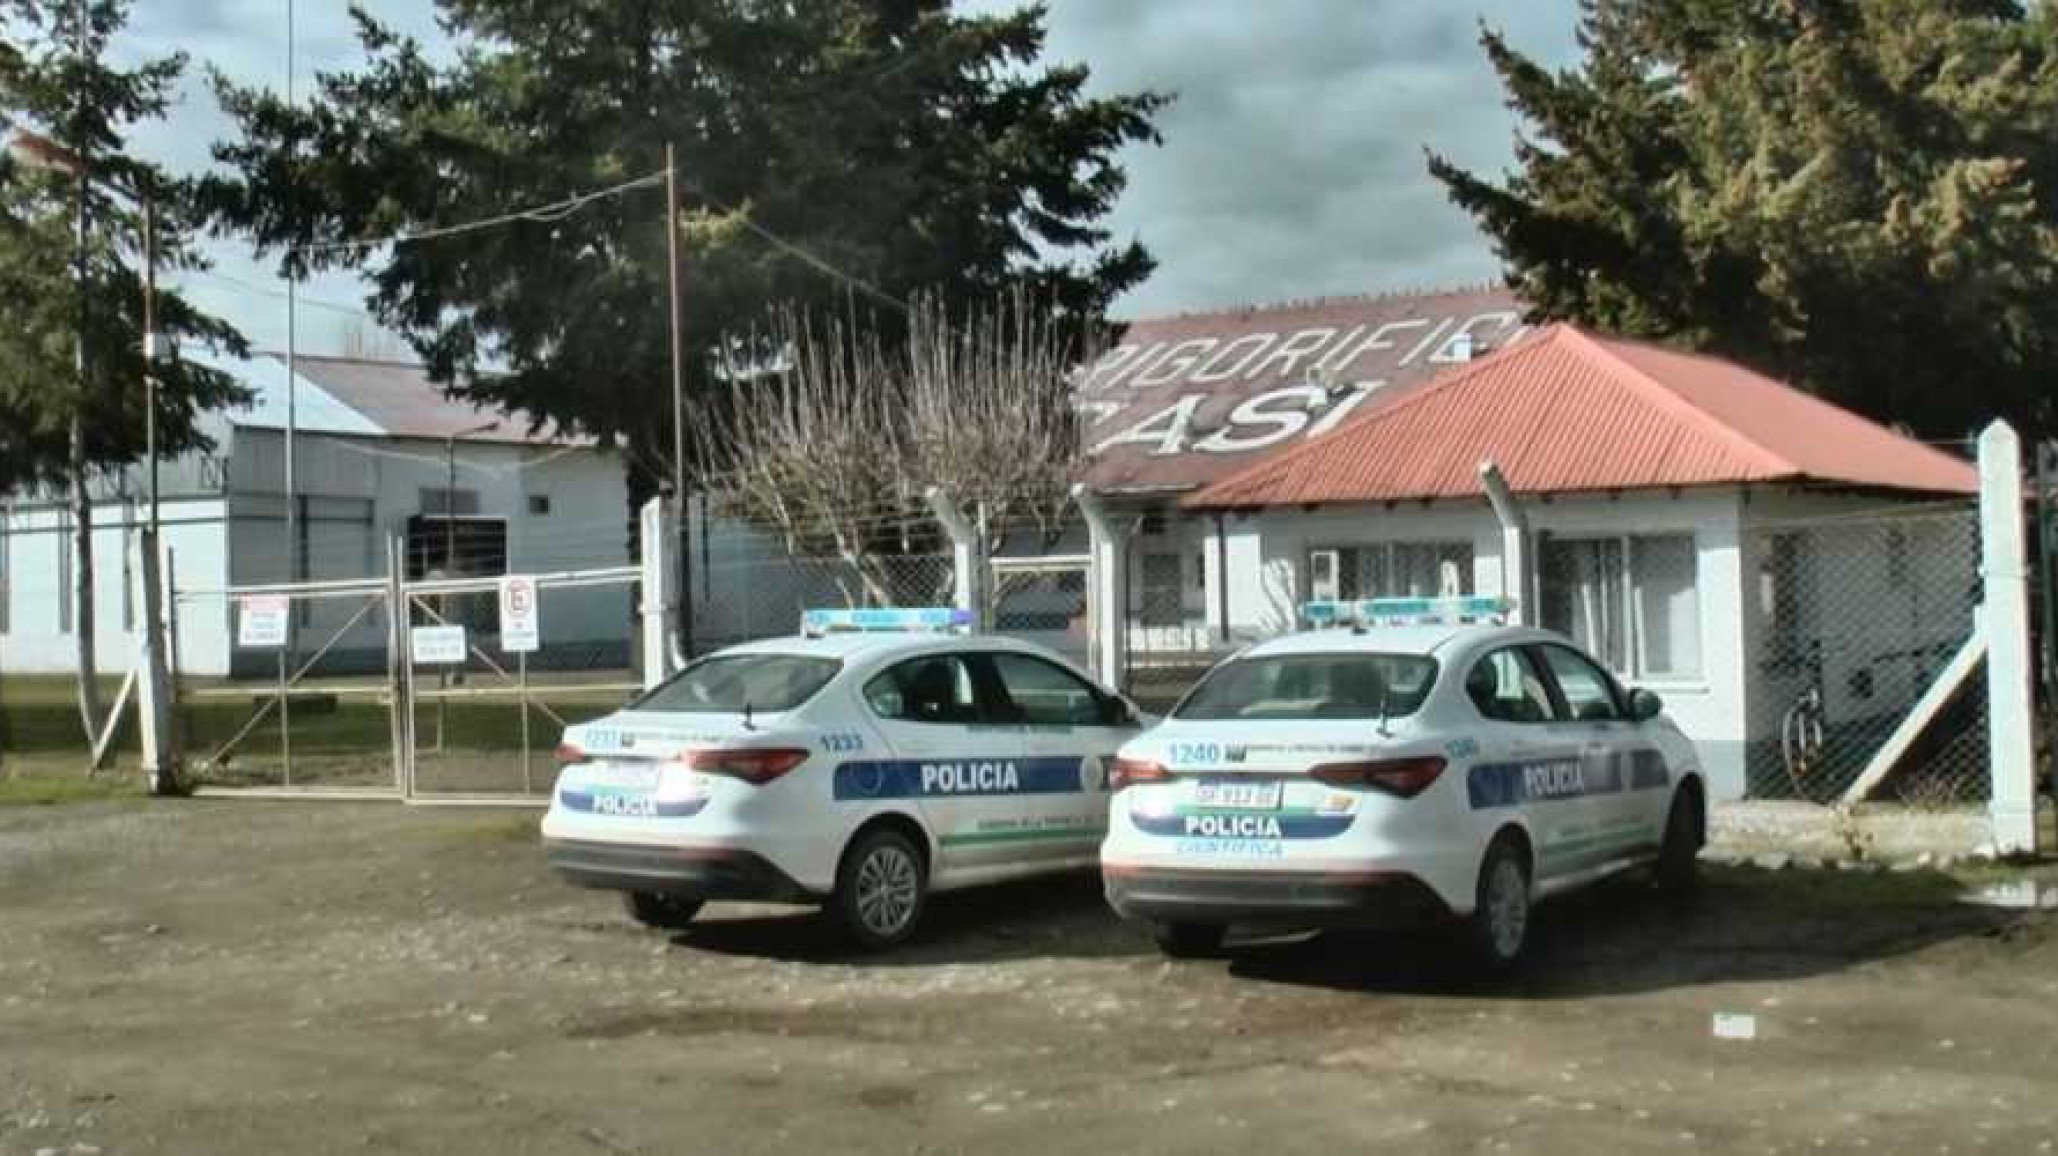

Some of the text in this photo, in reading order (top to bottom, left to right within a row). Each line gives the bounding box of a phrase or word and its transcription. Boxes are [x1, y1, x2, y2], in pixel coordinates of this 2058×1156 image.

[1169, 743, 1220, 763] 1240
[919, 762, 1020, 792] POLICIA
[1523, 760, 1585, 797] POLICIA
[592, 794, 658, 815] POLICIA
[1185, 815, 1283, 837] POLICIA
